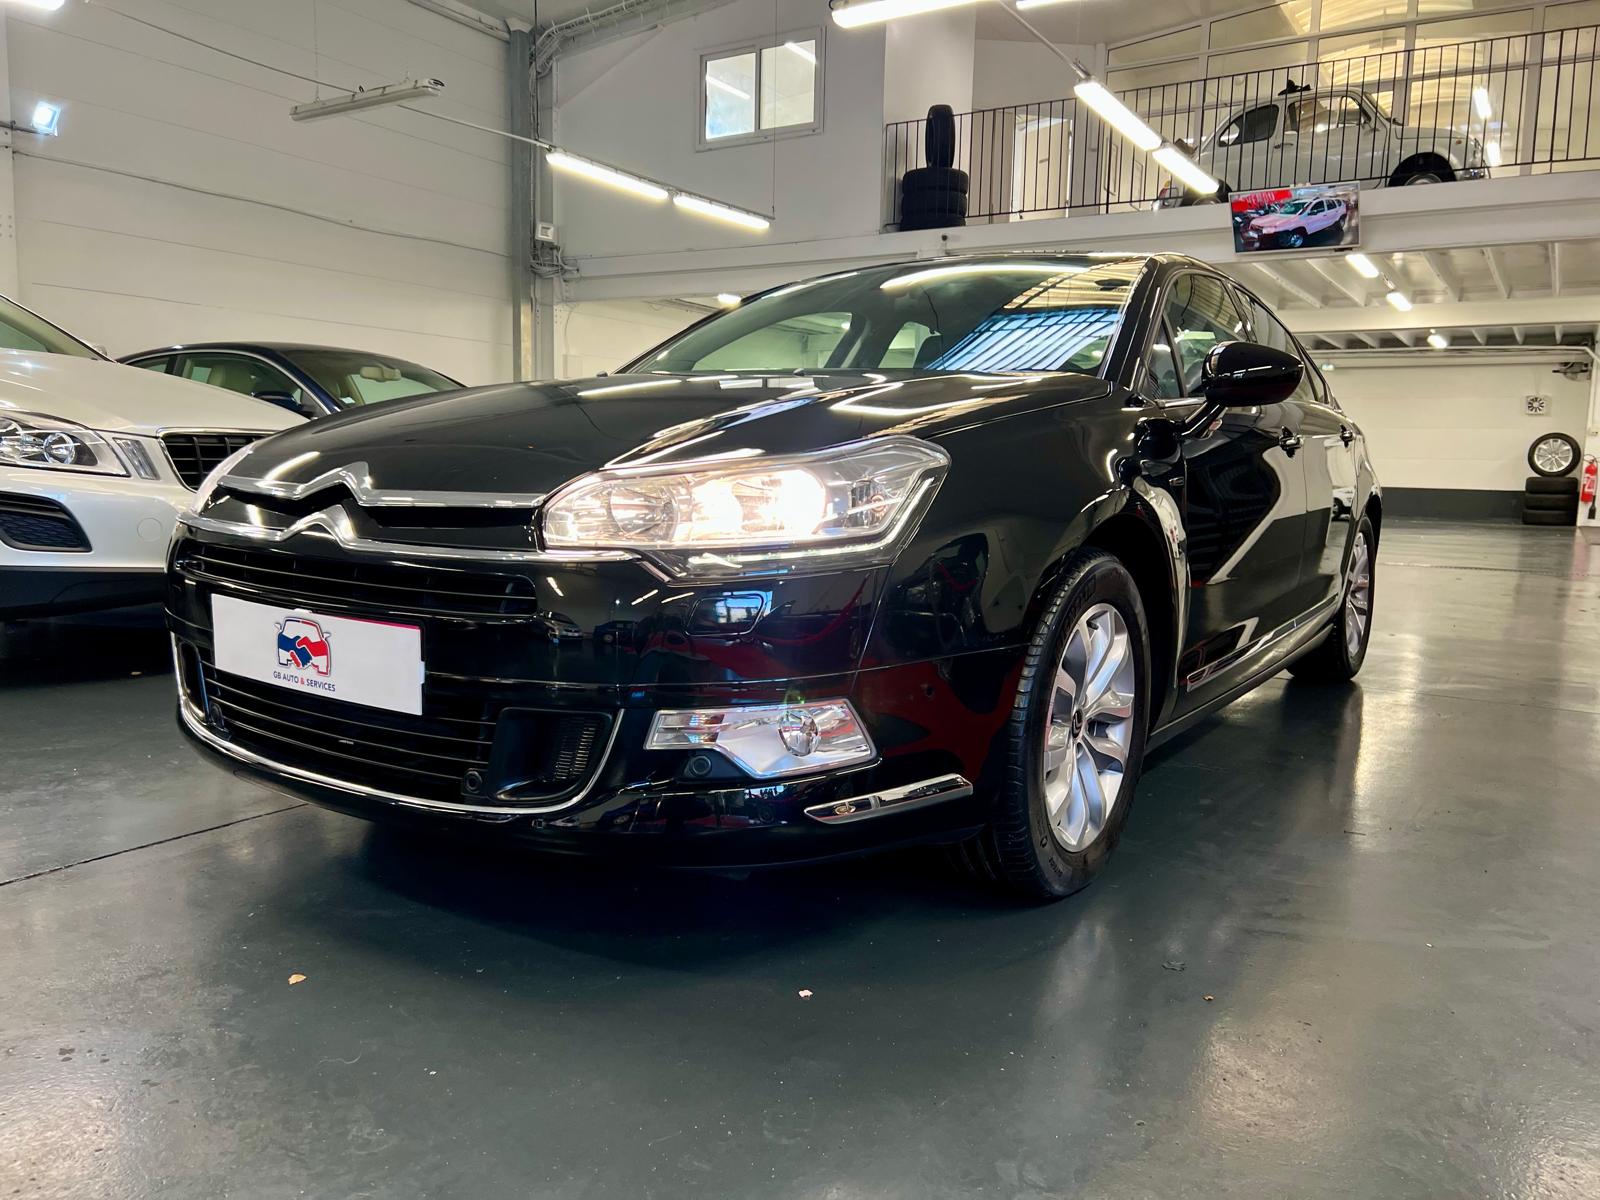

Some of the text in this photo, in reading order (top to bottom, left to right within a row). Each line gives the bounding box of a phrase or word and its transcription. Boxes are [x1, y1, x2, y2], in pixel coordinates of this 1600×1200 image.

[273, 671, 336, 692] GB AUTO & SERVICES
